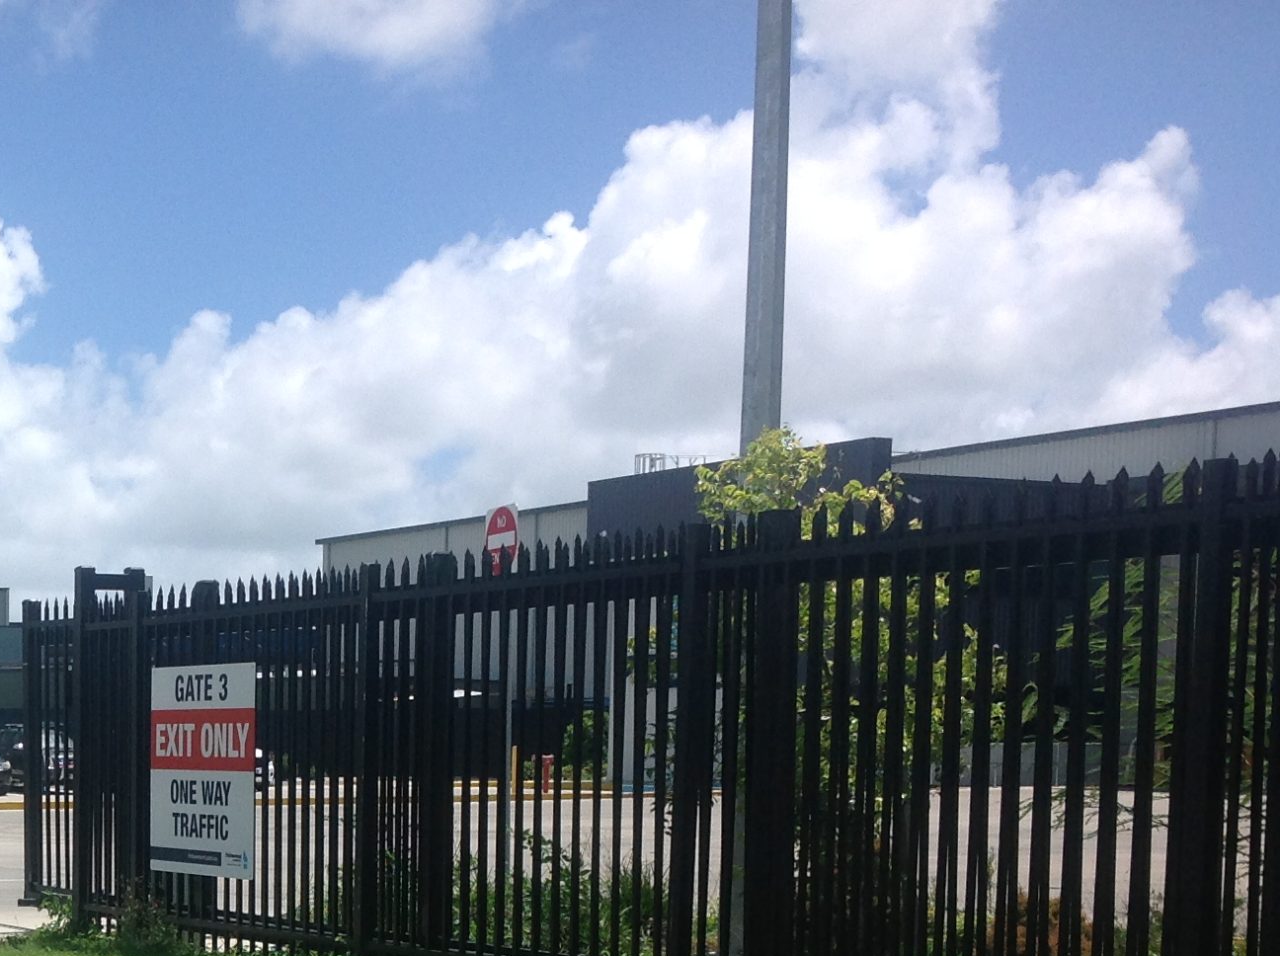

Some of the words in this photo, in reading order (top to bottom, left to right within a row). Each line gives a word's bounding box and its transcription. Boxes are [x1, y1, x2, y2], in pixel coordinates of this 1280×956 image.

[496, 514, 508, 529] NO
[175, 674, 213, 702] GATE
[218, 673, 228, 701] 3
[155, 723, 195, 758] EXIT
[200, 722, 250, 758] ONLY
[170, 779, 197, 805] ONE
[201, 780, 231, 807] WAY
[172, 812, 229, 841] TRAFFIC
